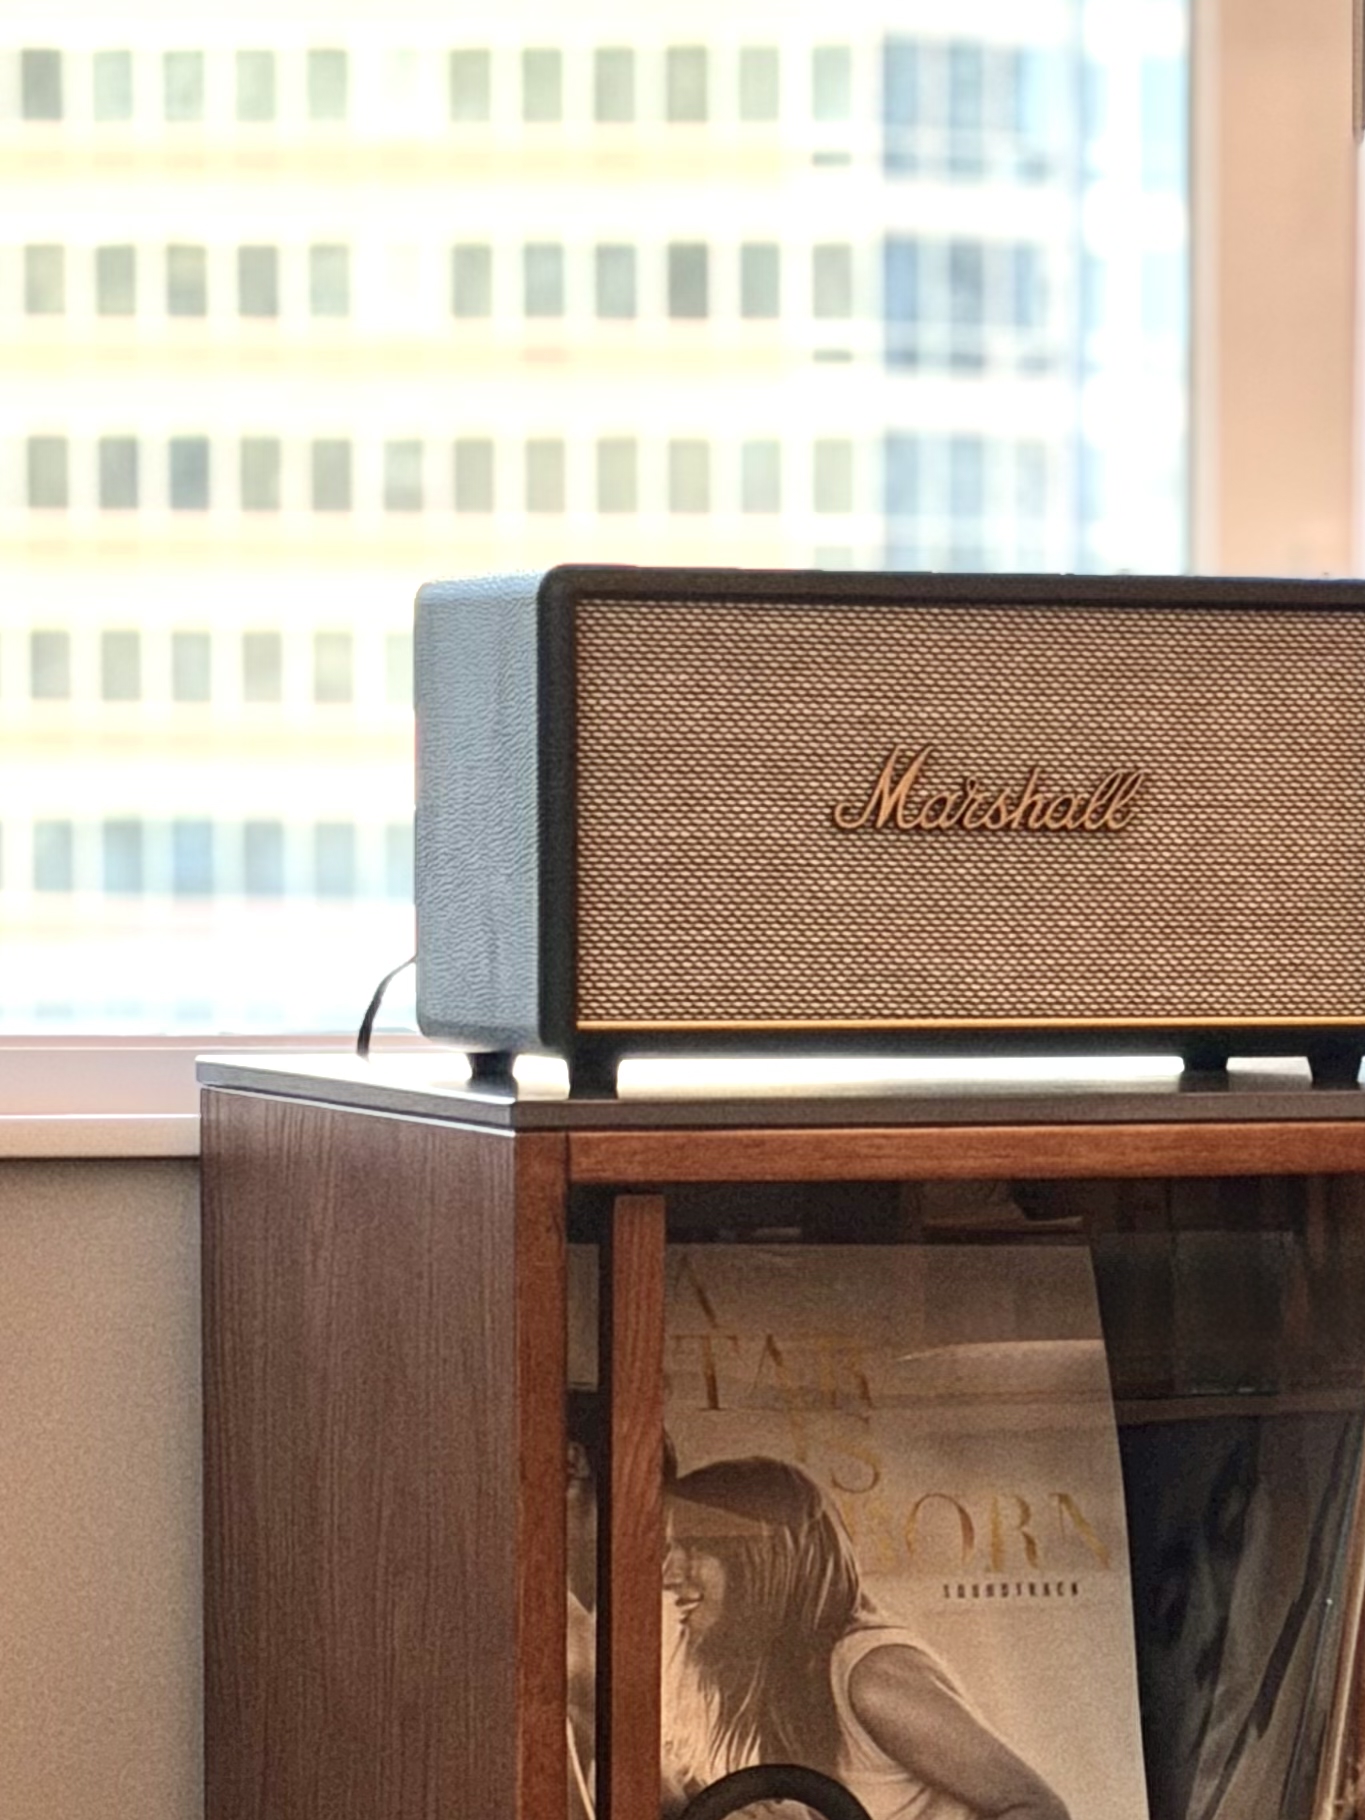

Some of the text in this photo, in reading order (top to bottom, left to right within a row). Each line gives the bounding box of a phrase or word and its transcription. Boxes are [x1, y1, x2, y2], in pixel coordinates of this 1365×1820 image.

[833, 744, 1145, 831] Marshall
[838, 1492, 1112, 1573] BORN
[943, 1581, 1079, 1600] SOUNDTRACK
